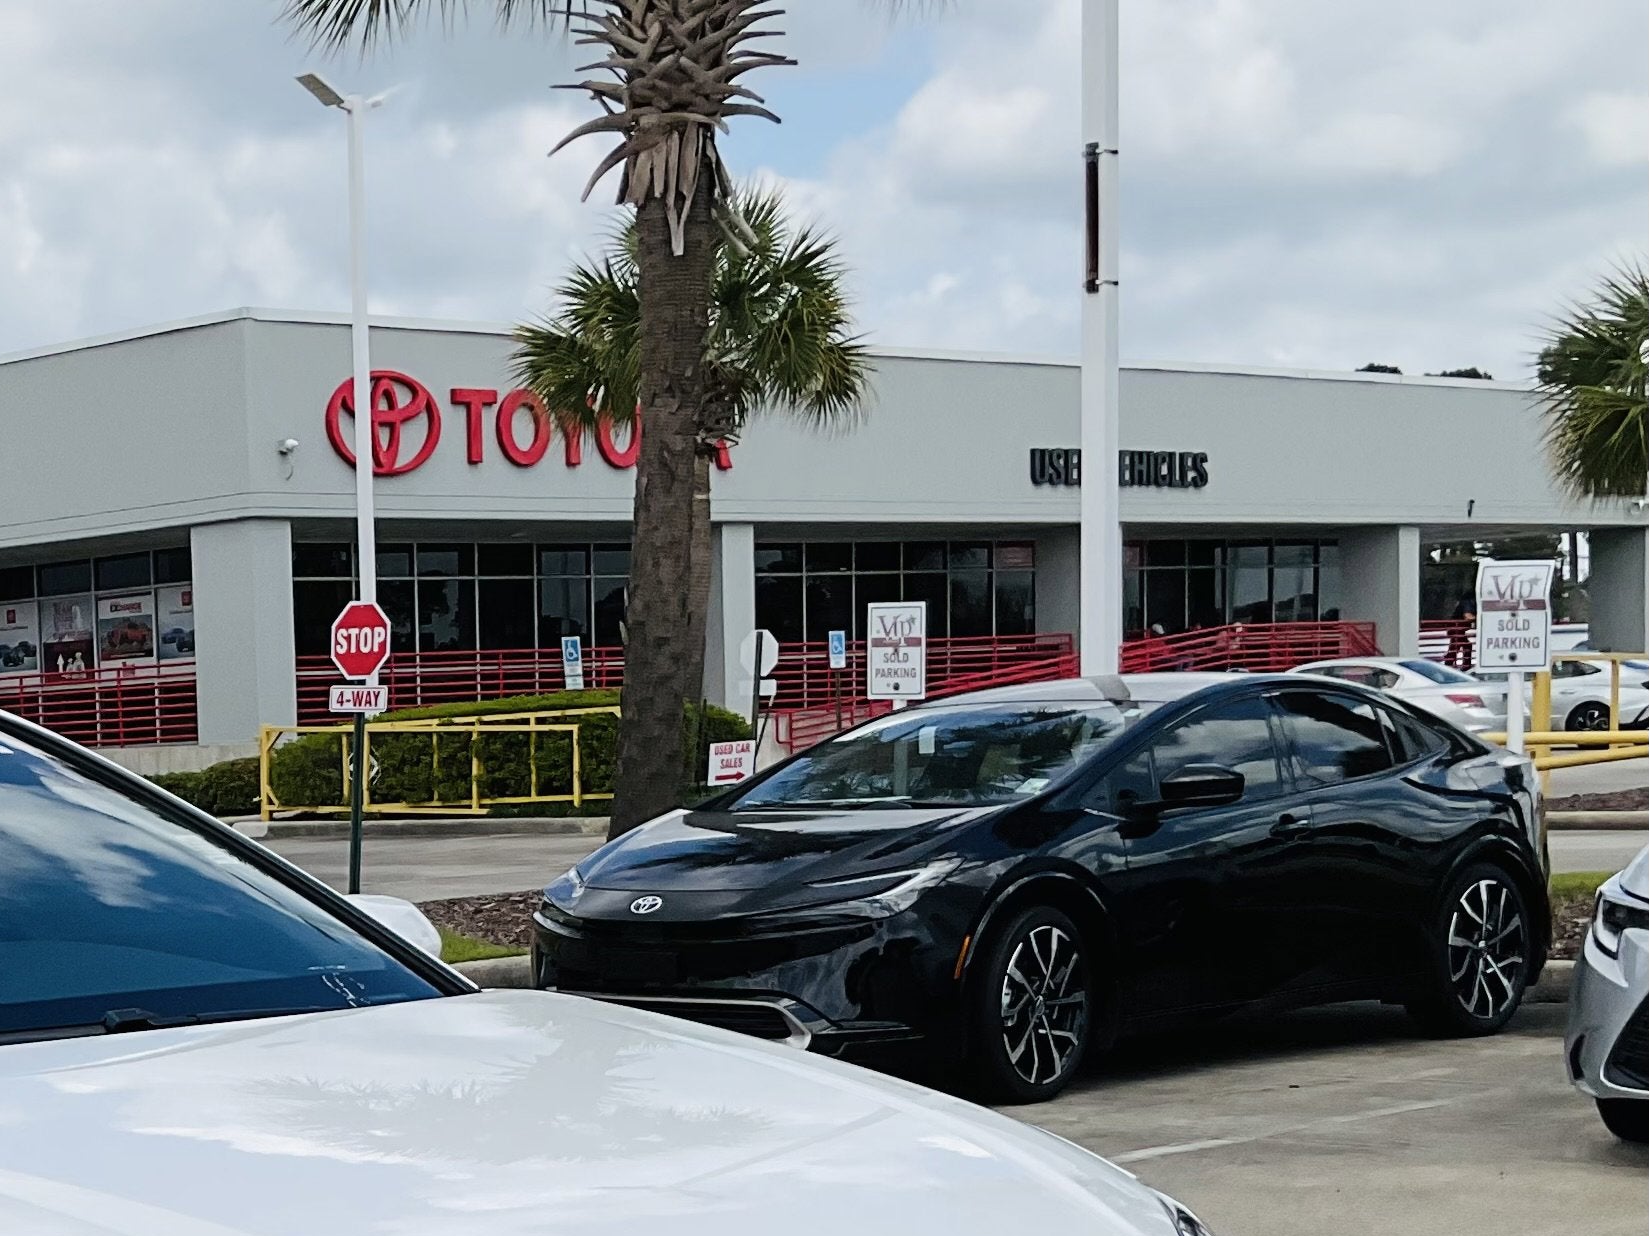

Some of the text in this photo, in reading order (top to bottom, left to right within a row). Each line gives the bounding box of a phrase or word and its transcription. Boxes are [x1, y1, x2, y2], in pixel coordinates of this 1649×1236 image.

[1030, 448, 1209, 489] USE EHICLES
[1498, 619, 1530, 631] SOLD
[336, 627, 385, 654] STOP
[1487, 637, 1540, 649] PARKING
[883, 653, 909, 663] SOLD
[875, 667, 917, 678] PARKING
[336, 691, 380, 707] 4-WAY
[714, 743, 751, 755] USED CAR
[720, 757, 743, 769] SALES
